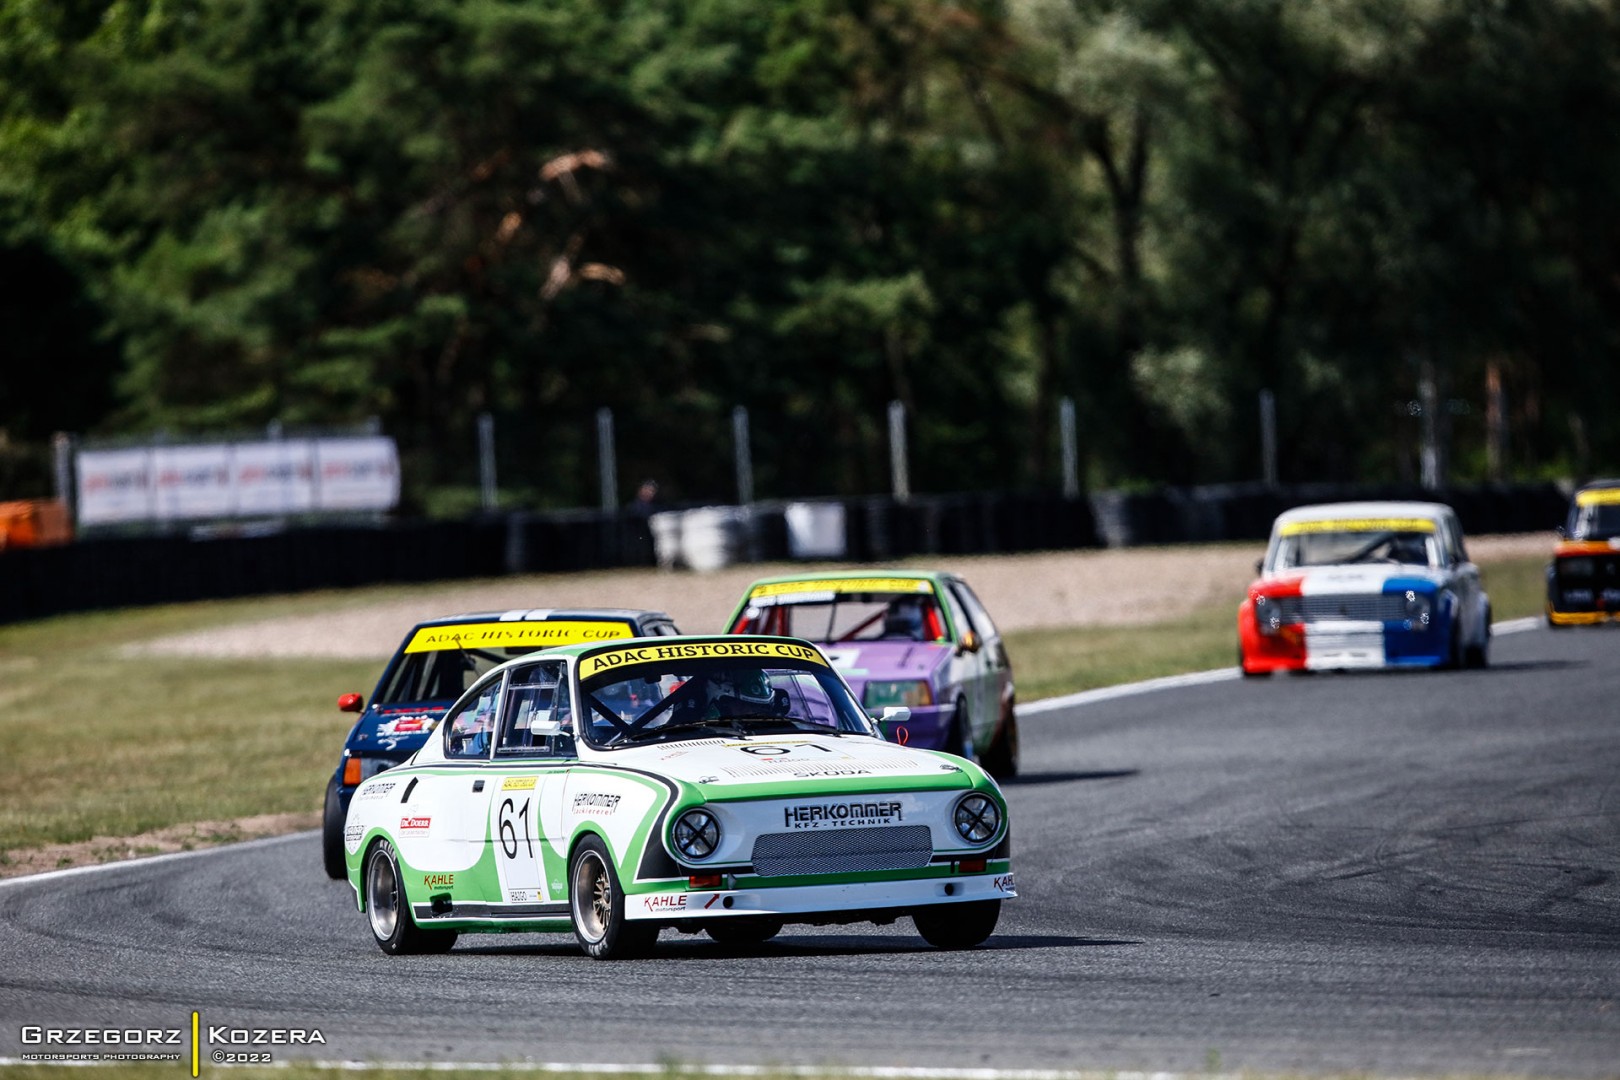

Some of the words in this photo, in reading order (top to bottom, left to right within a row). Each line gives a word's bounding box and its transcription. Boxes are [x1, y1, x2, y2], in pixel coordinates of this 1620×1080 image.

[426, 632, 474, 643] ADAC
[582, 630, 621, 638] CUP
[593, 649, 652, 670] ADAC
[656, 643, 769, 659] HISTORIC
[774, 644, 814, 660] CUP
[740, 743, 832, 756] 61
[572, 791, 621, 813] HERKOMMER
[784, 801, 903, 828] HERKOMMER
[499, 797, 533, 860] 61
[424, 874, 454, 890] KAHLE
[644, 895, 688, 912] KAHLE
